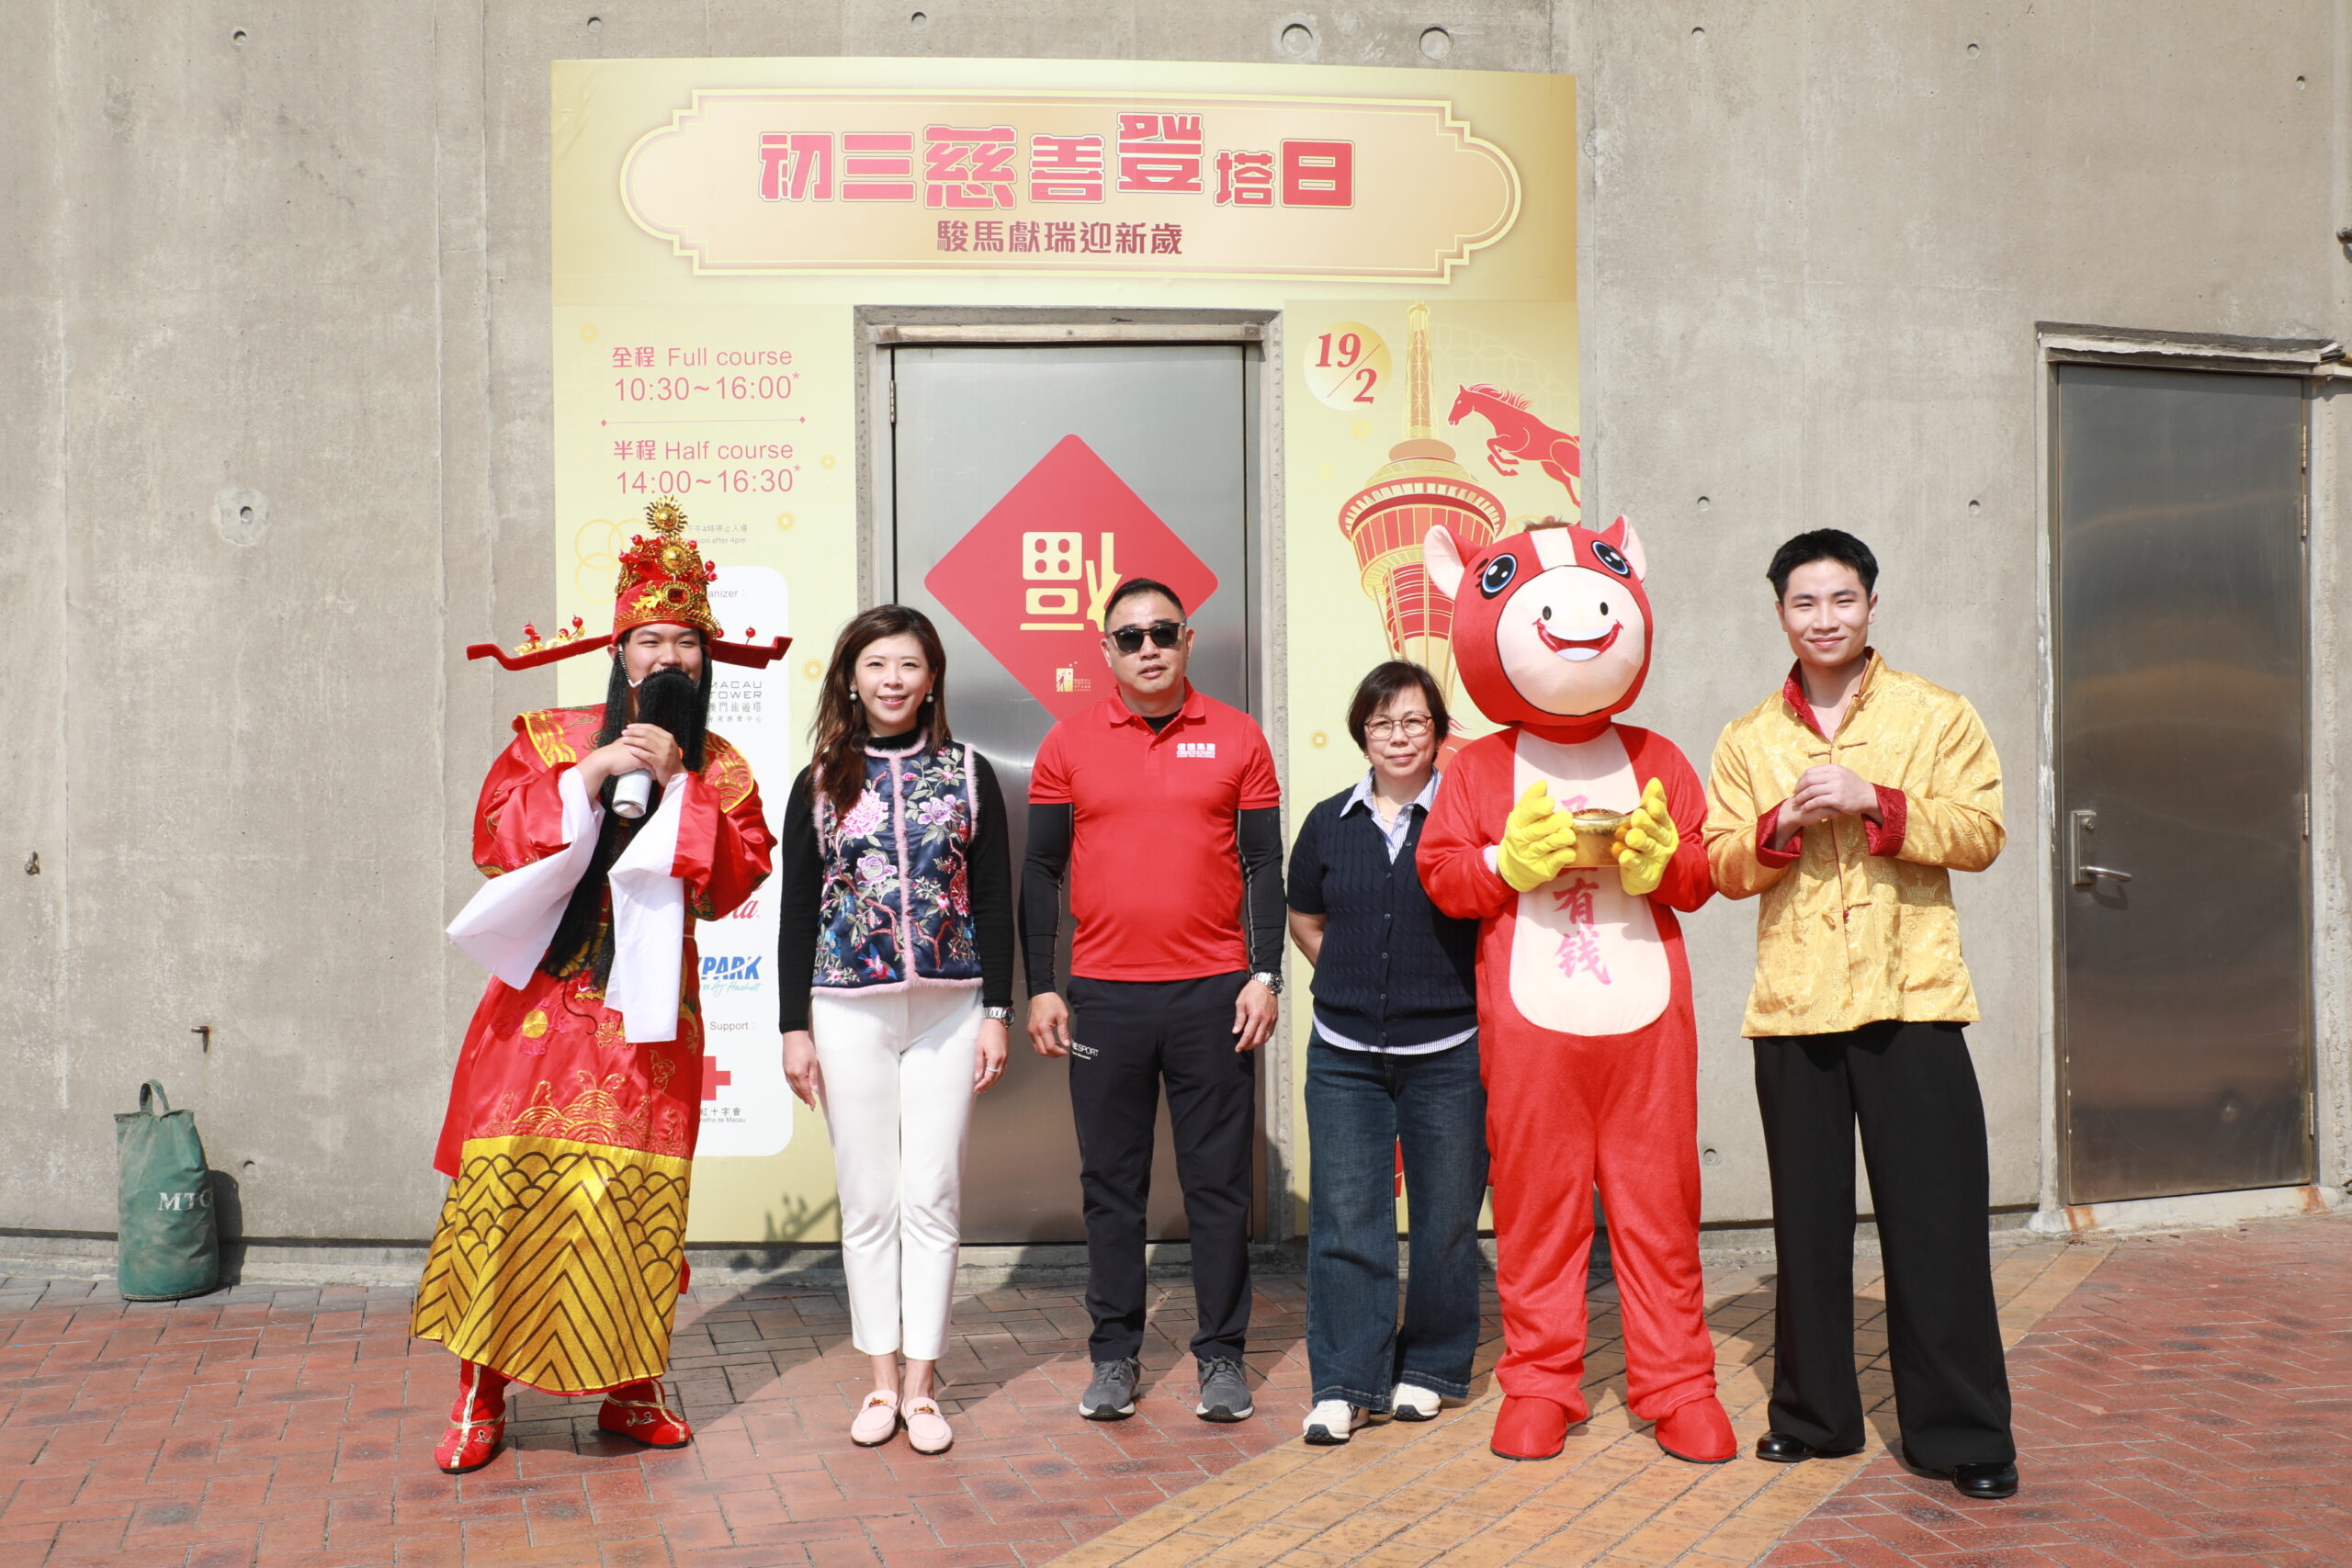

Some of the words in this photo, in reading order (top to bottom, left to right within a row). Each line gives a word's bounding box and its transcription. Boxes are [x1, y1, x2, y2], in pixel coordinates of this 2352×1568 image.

[758, 111, 1355, 211] 初三慈善登塔日
[937, 220, 1182, 255] 駿馬獻瑞迎新歲
[612, 346, 655, 368] 全程
[668, 347, 707, 367] Full
[717, 350, 793, 367] course
[613, 439, 656, 461] 半程
[665, 440, 709, 460] Half
[718, 443, 794, 460] course
[698, 956, 763, 980] PARK
